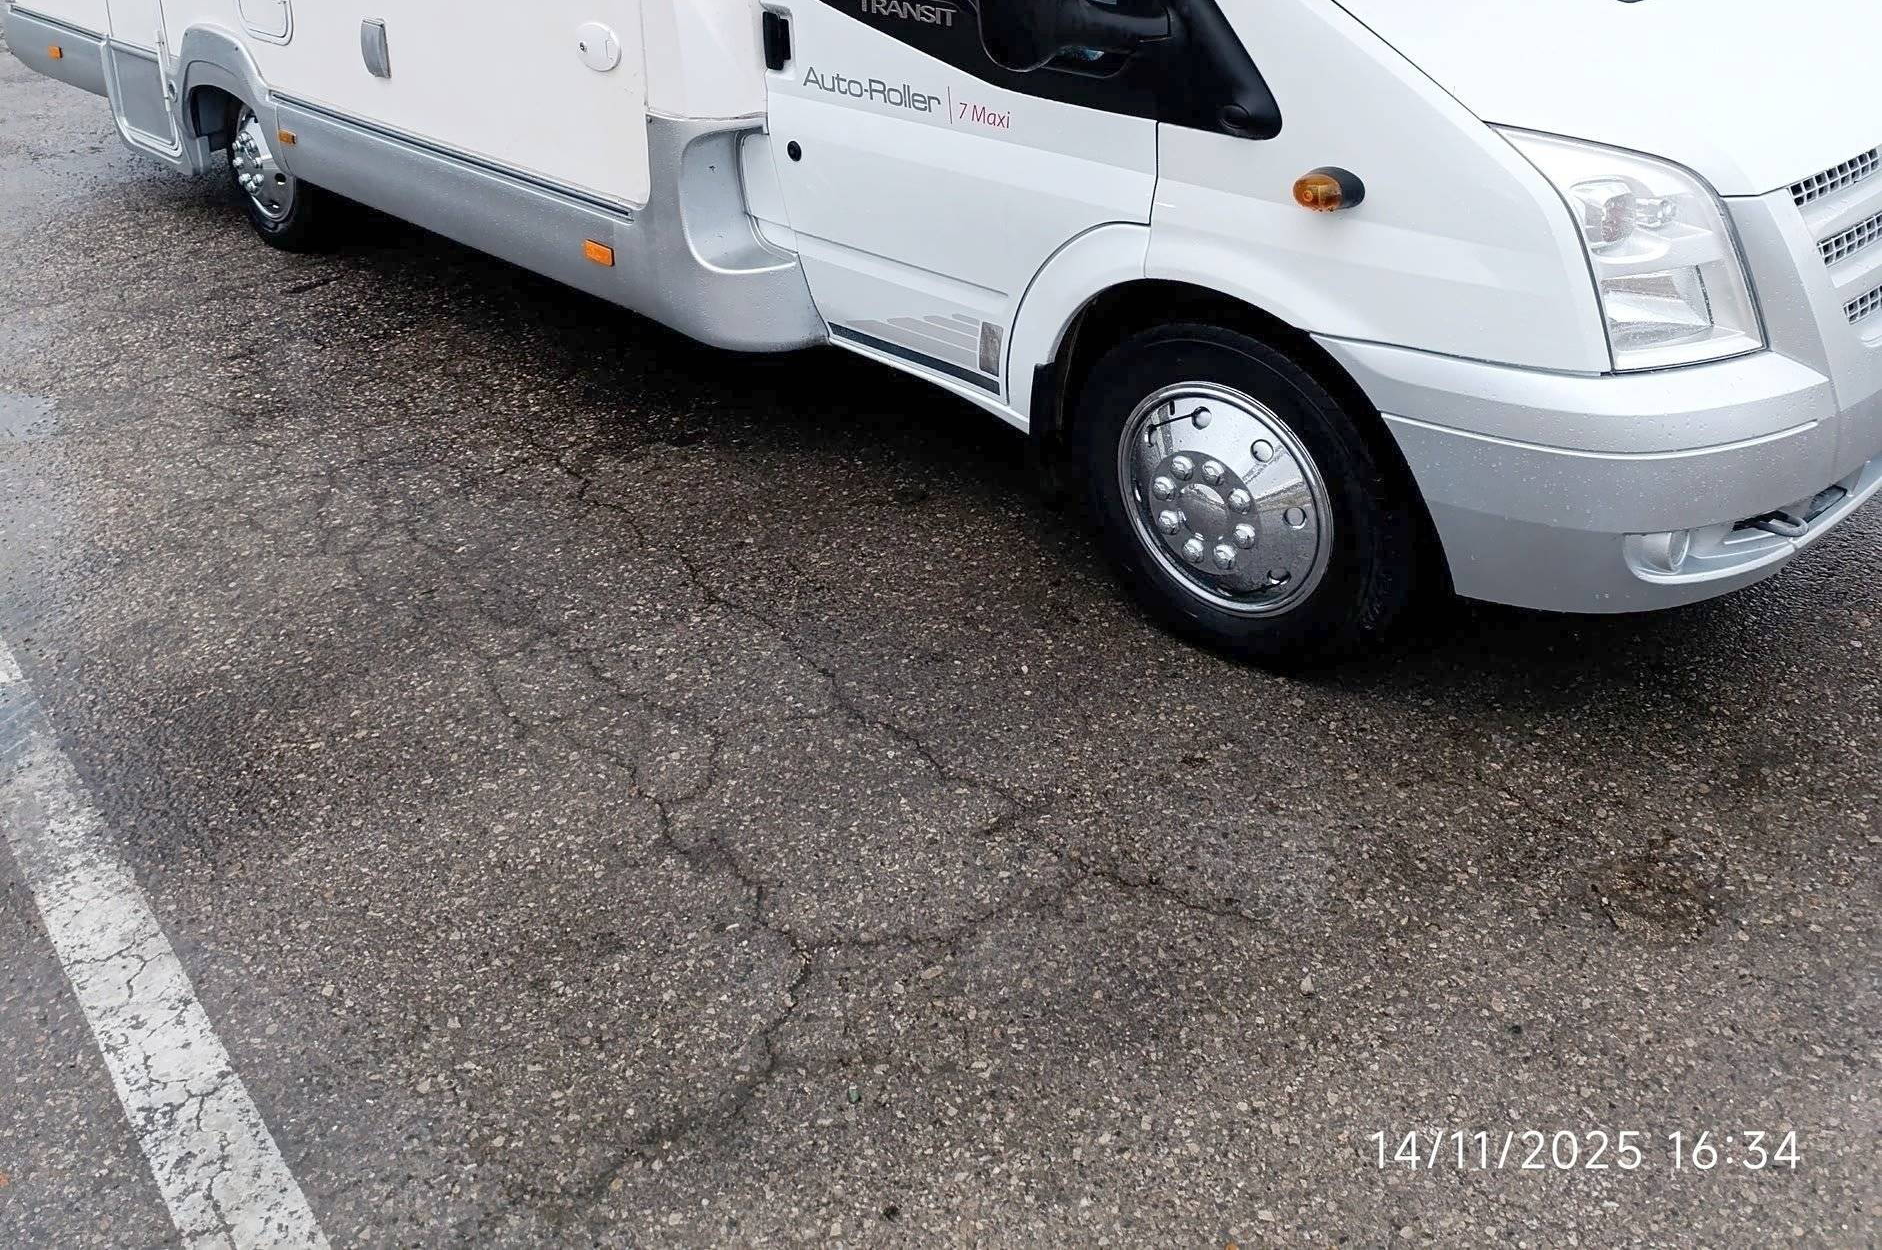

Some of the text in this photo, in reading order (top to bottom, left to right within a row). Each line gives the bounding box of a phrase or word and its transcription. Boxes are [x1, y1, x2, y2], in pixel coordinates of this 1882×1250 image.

[803, 66, 1011, 128] Auto-Roller 7 Maxi
